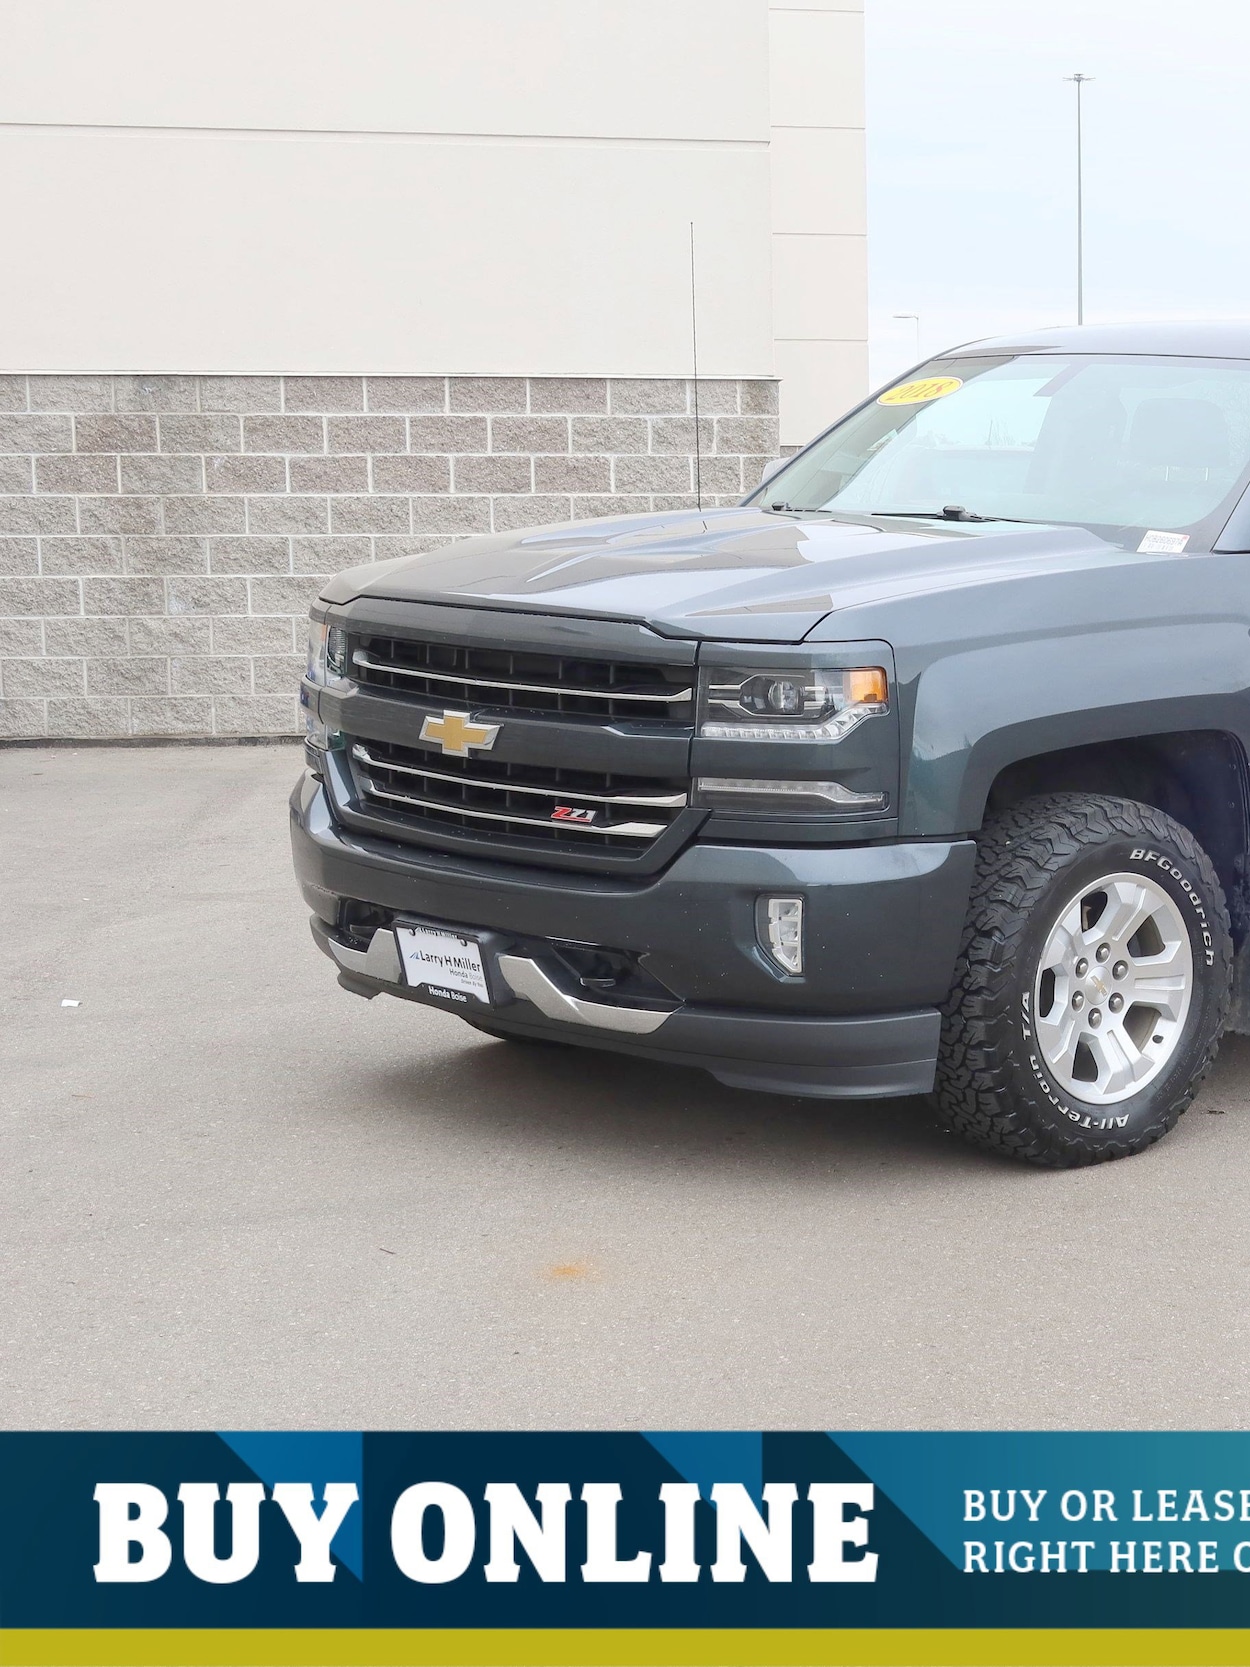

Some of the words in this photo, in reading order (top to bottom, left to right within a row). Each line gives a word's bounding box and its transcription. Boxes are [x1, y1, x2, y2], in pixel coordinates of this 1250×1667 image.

[885, 380, 954, 401] 2018
[550, 806, 597, 823] Z71
[1129, 848, 1214, 967] BFGoodrich
[419, 950, 443, 967] Larry
[444, 955, 453, 966] H
[453, 957, 480, 972] Miller
[449, 968, 468, 979] Honda
[428, 985, 451, 999] Honda
[450, 990, 468, 1003] Boise
[1021, 992, 1032, 1041] T/A
[1029, 1054, 1131, 1131] All-Terrain
